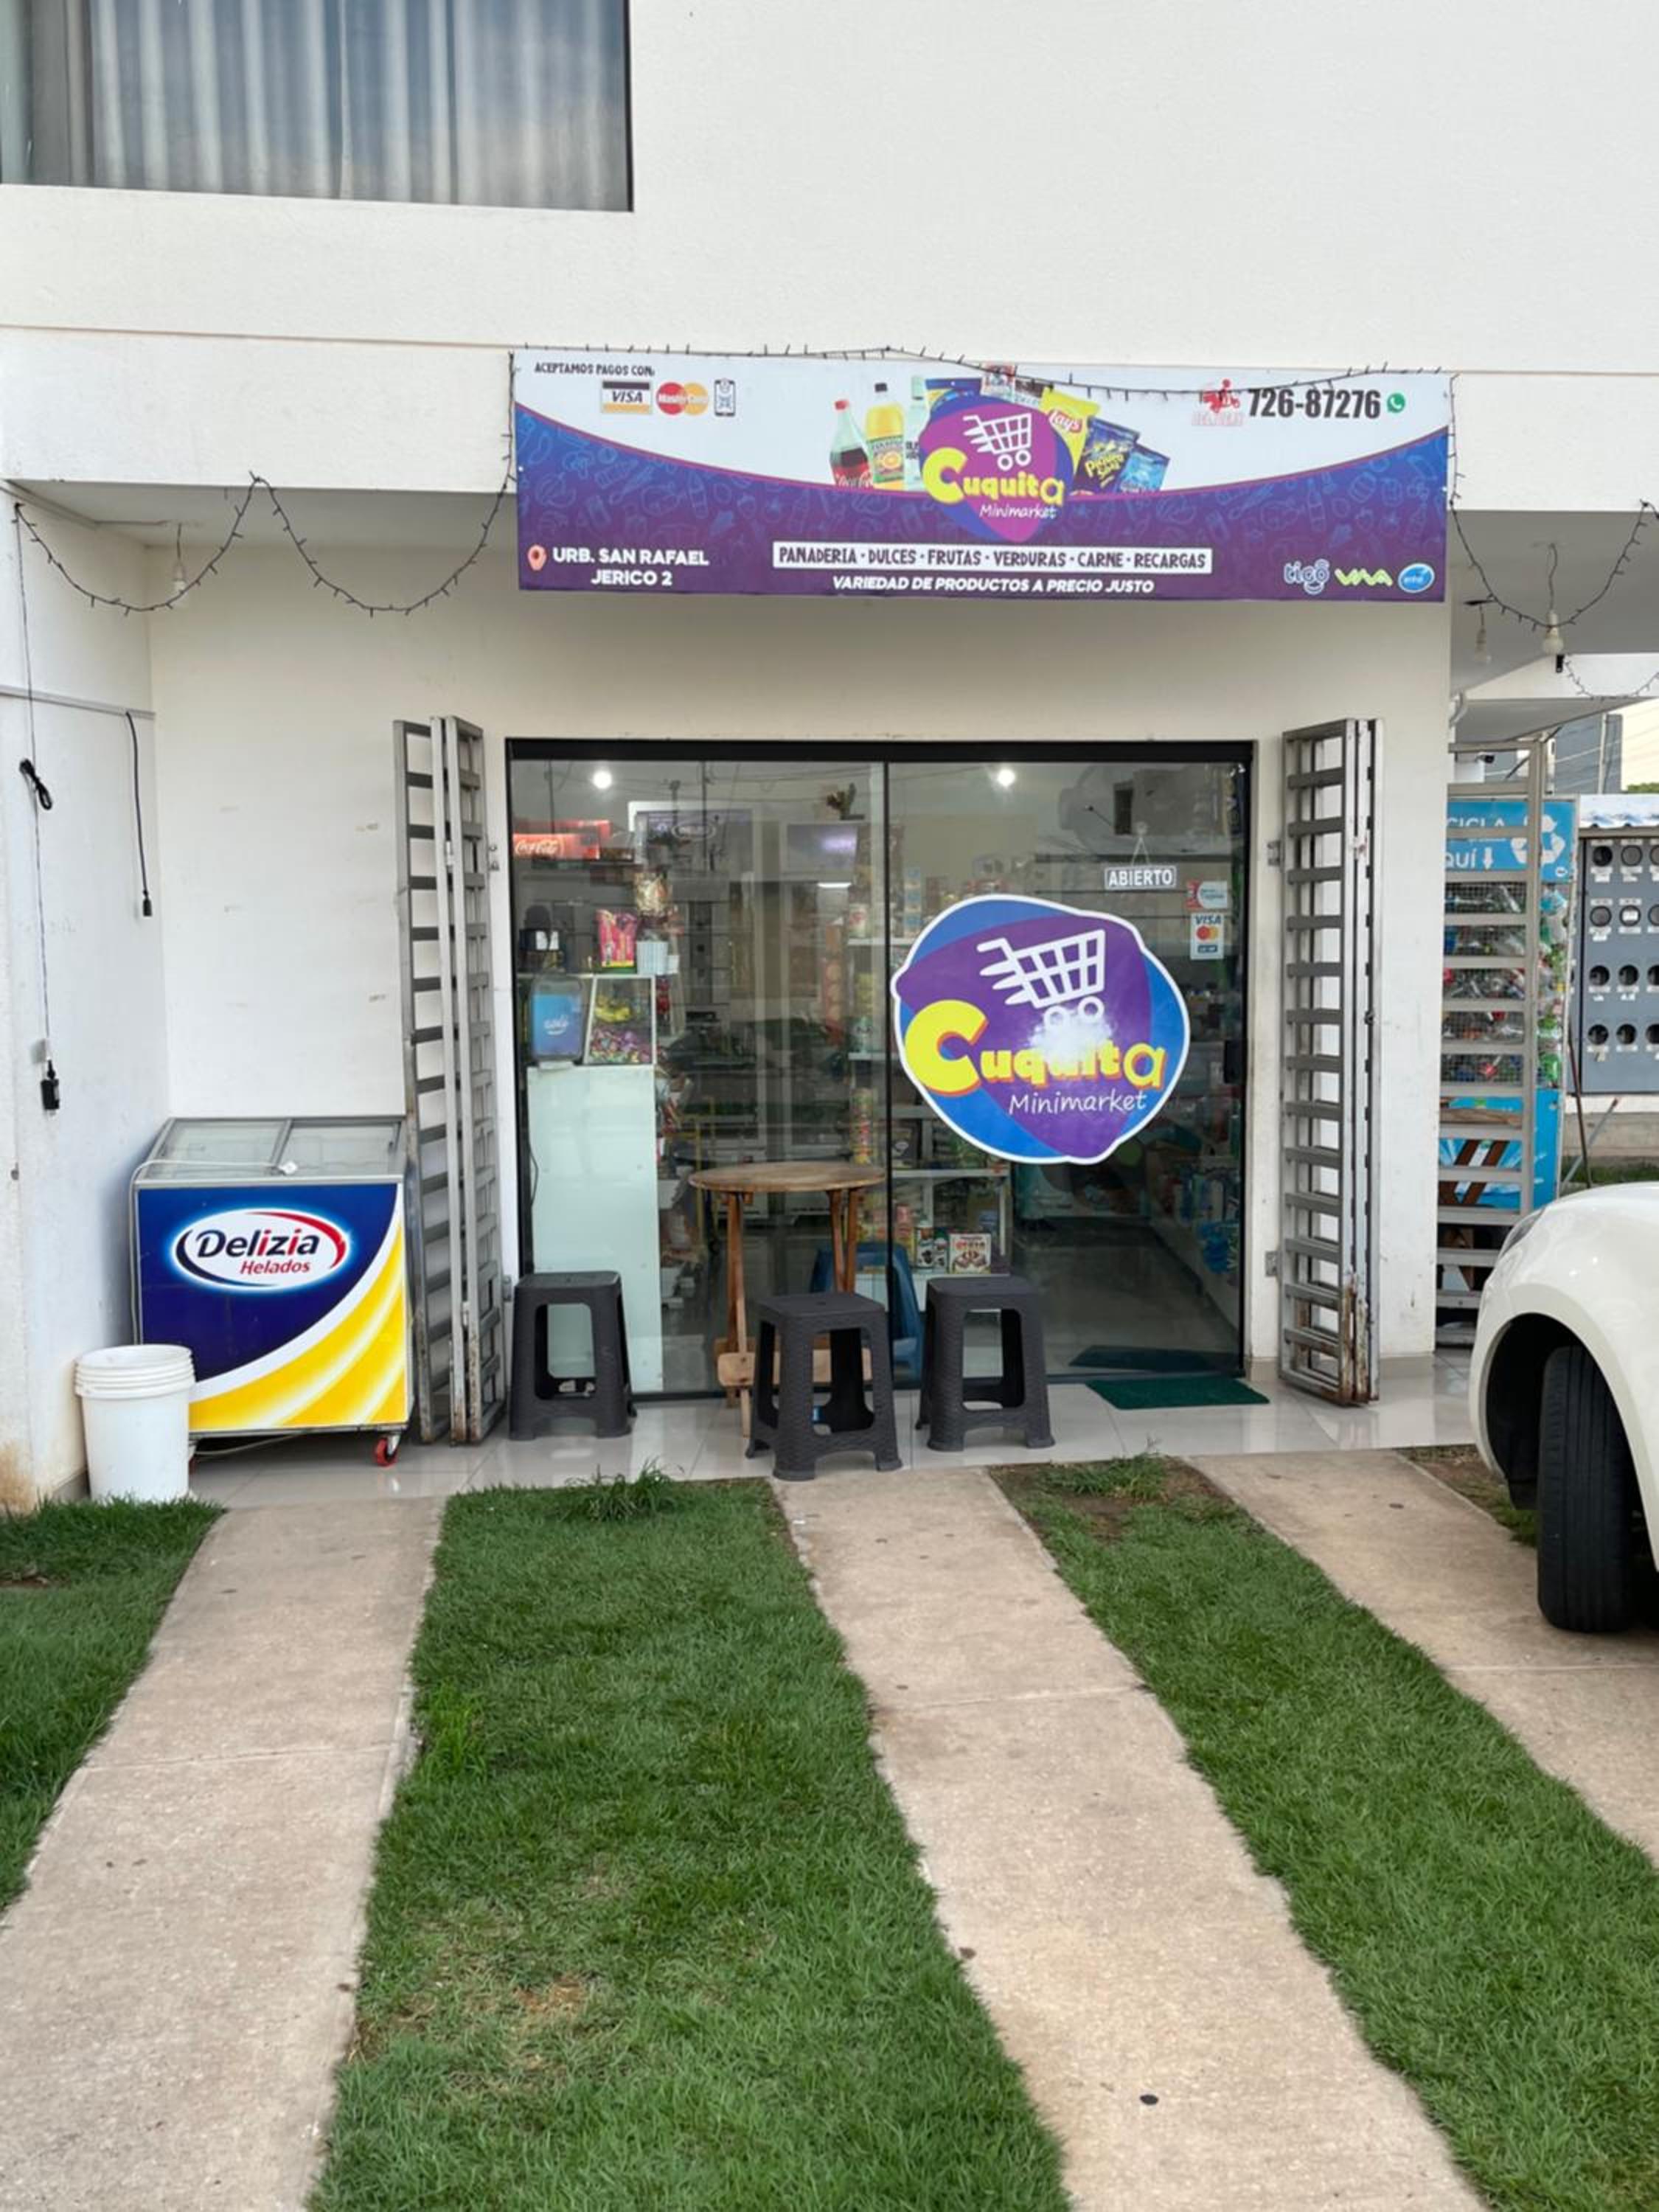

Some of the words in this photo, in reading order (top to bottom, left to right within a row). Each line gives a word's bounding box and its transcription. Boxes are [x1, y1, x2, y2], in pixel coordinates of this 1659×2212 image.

[535, 362, 594, 375] ACEPTAMOS
[596, 364, 629, 376] PAGOS
[612, 392, 643, 403] VISA
[1248, 388, 1381, 419] 726-87276
[922, 446, 1065, 507] Cuquita
[978, 504, 1057, 519] Minimarket
[553, 547, 595, 563] URB.
[599, 548, 636, 564] SAN
[639, 549, 709, 566] RAFAEL
[779, 546, 858, 564] PANADERIA
[868, 549, 917, 565] DULCES
[928, 549, 981, 566] FRUTAS
[994, 551, 1066, 567] VERDURAS
[1077, 552, 1123, 568] CARNE
[1134, 553, 1206, 569] RECARGAS
[591, 569, 658, 585] JERICO
[661, 570, 672, 586] 2
[832, 576, 909, 591] VARIEDAD
[911, 577, 933, 591] DE
[934, 577, 1029, 591] PRODUCTOS
[1032, 579, 1044, 592] A
[1046, 579, 1103, 593] PRECIO
[1105, 580, 1155, 593] JUSTO
[1108, 869, 1172, 887] ABIERTO
[1009, 1088, 1147, 1115] Minimarket
[195, 1228, 320, 1258] Delizia
[240, 1259, 310, 1275] Helados
